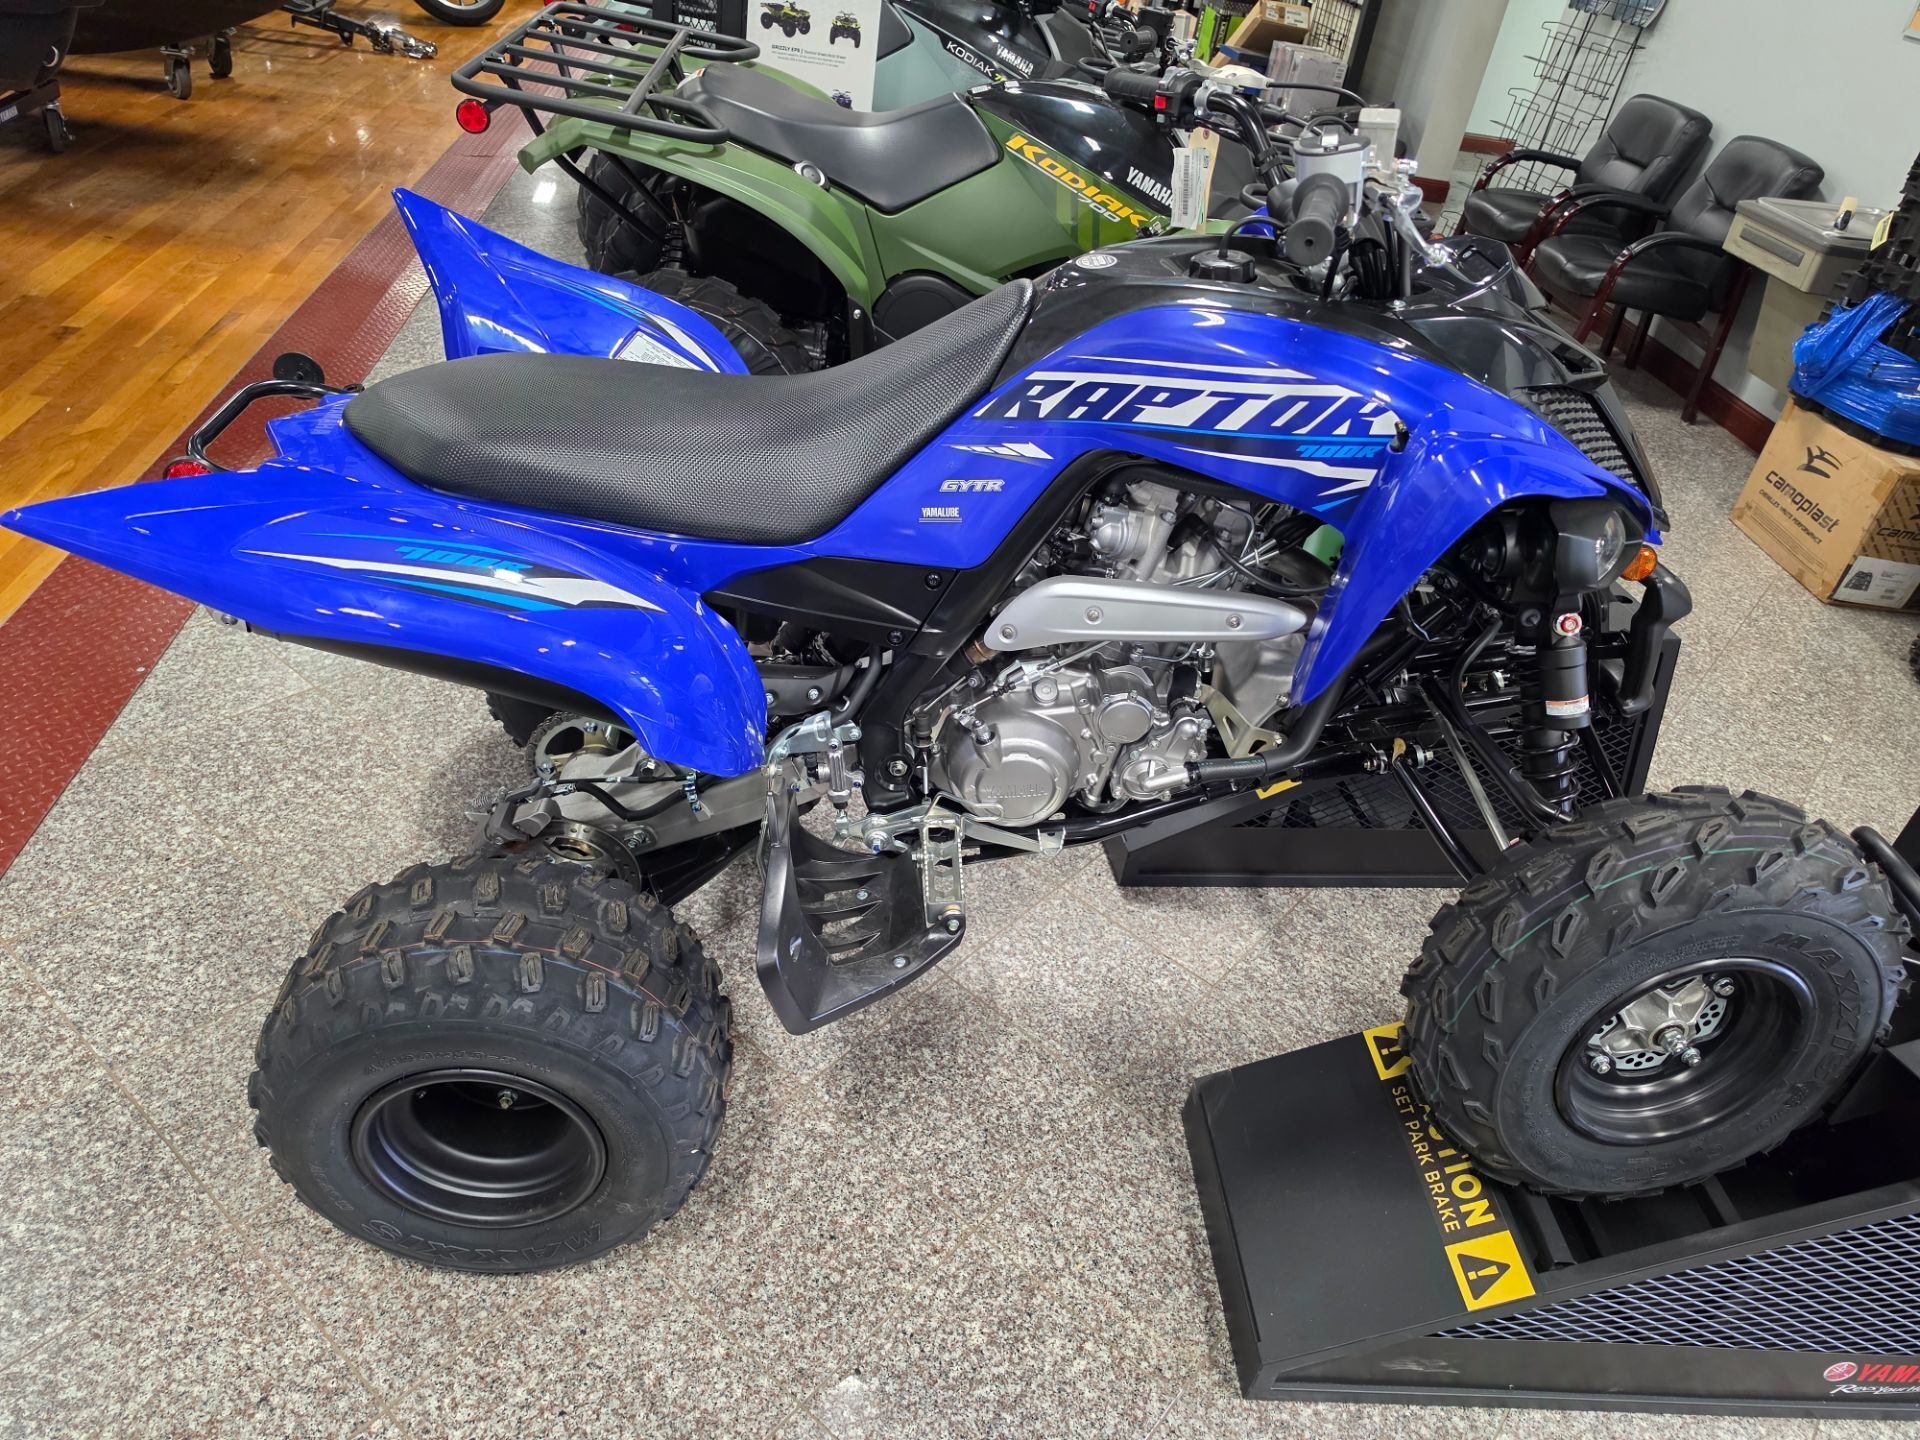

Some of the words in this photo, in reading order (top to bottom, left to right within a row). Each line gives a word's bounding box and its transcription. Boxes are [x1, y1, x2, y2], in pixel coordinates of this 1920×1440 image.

[946, 41, 995, 77] KODIAK
[996, 43, 1034, 76] YAMAHA
[1005, 135, 1149, 227] KODIAK
[1077, 192, 1121, 223] 700
[982, 378, 1394, 437] RAPTOR
[1296, 445, 1384, 458] 700R
[939, 479, 1005, 492] GYTR
[1765, 469, 1841, 534] camoplast
[921, 507, 960, 518] YAMALUBE
[395, 545, 534, 572] 700R
[1392, 1085, 1414, 1114] SET
[1405, 1119, 1435, 1167] PARK
[1424, 1169, 1461, 1234] BRAKE
